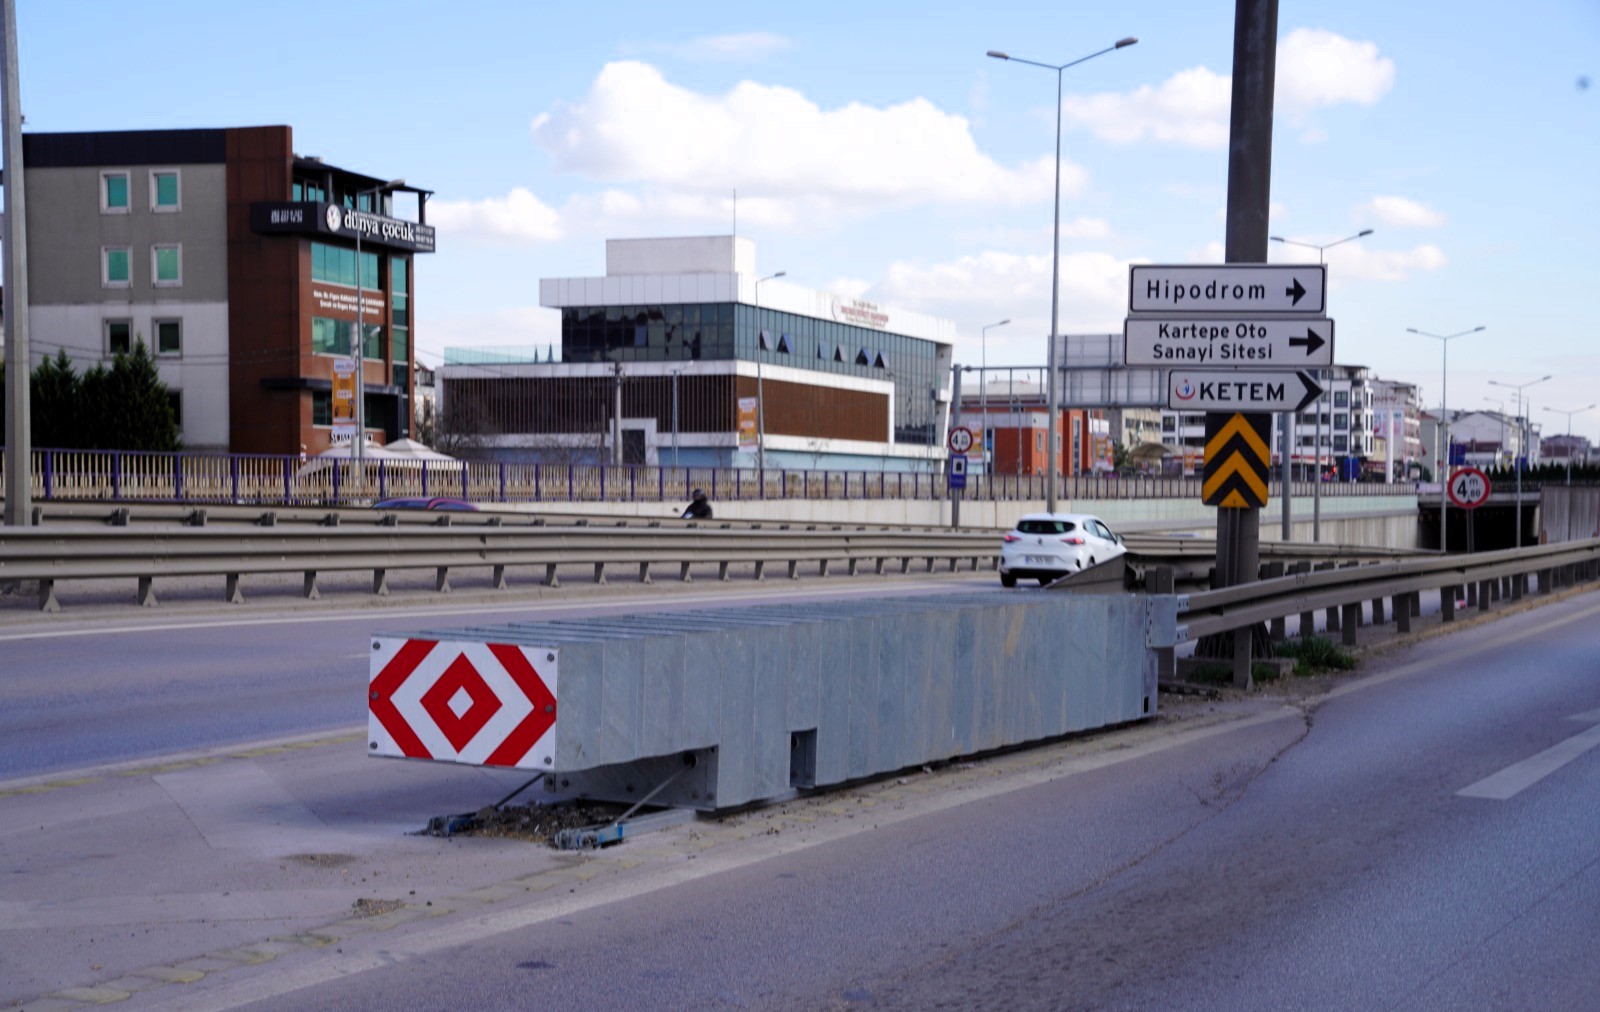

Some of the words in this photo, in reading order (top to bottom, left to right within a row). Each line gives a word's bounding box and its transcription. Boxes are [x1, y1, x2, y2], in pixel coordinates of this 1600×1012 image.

[344, 210, 379, 237] dünya
[382, 222, 415, 242] çocuk
[1147, 279, 1265, 304] Hipodrom
[1159, 323, 1230, 341] Kartepe
[1236, 323, 1267, 338] Oto
[1153, 343, 1213, 362] Sanayi
[1220, 343, 1272, 359] Sitesi
[1200, 382, 1285, 401] KETEM
[1457, 479, 1468, 498] 4
